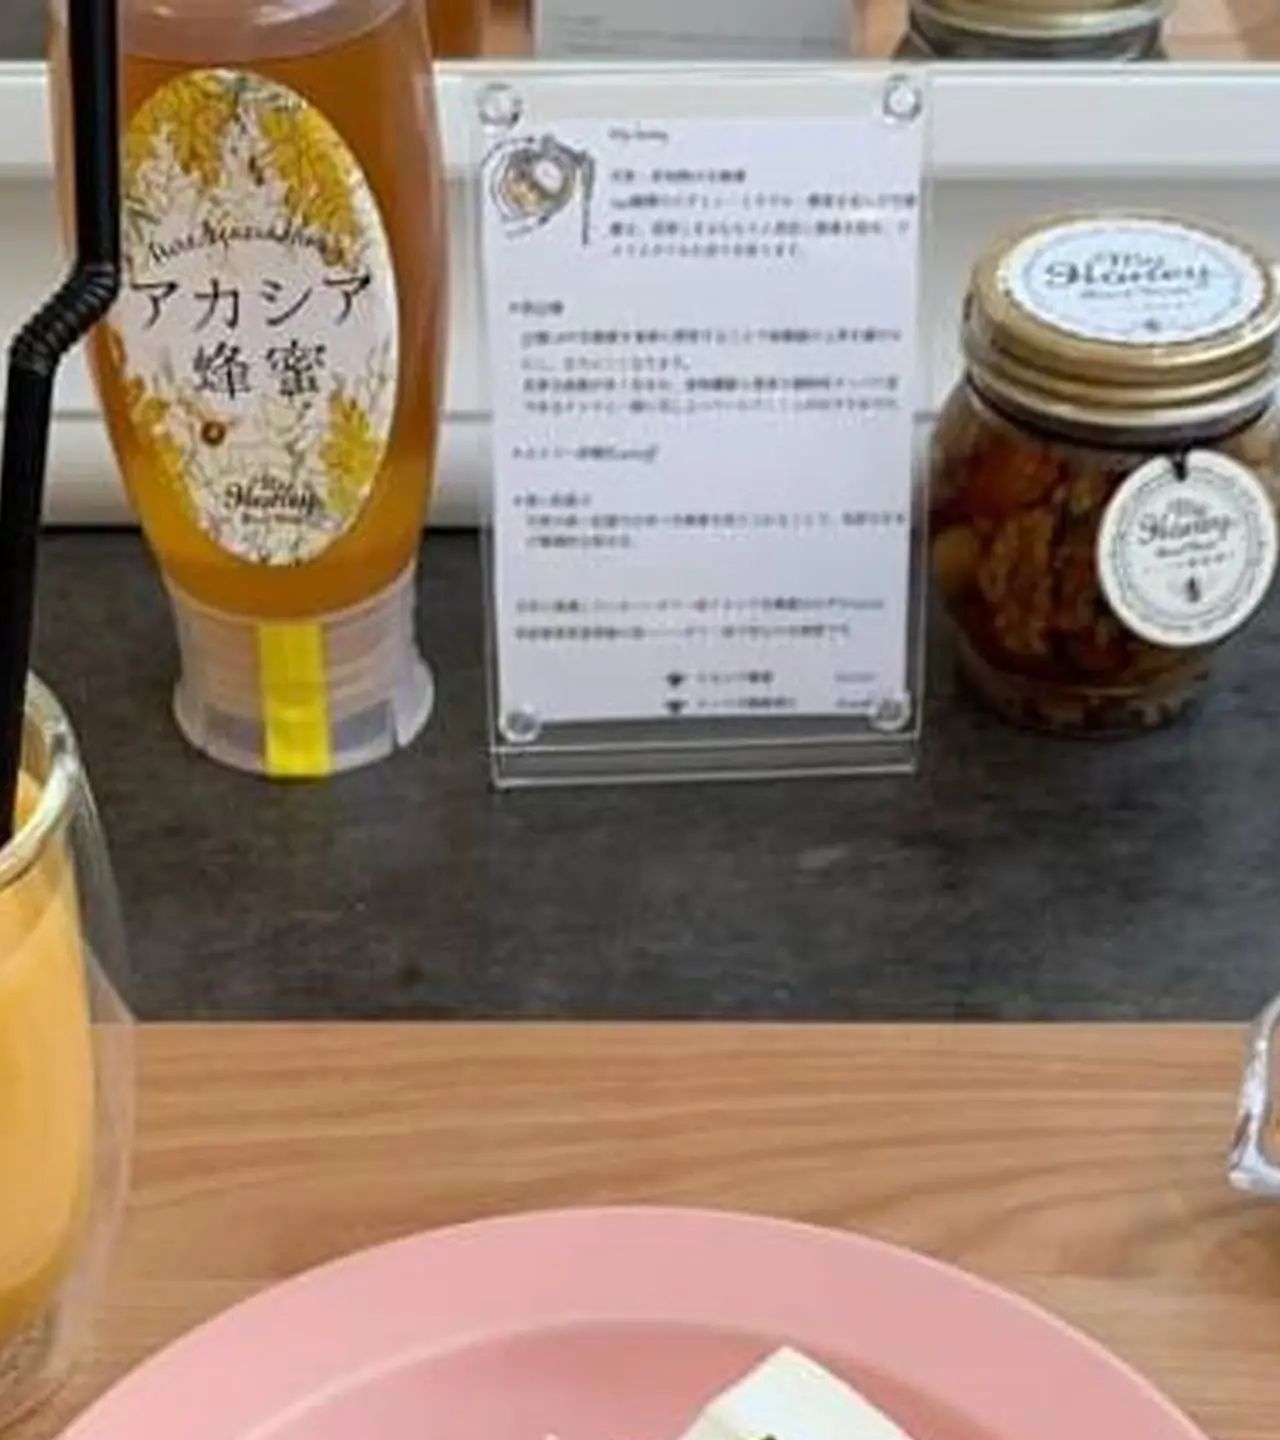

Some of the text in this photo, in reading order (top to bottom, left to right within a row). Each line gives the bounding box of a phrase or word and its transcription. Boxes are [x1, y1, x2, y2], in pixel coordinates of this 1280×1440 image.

[130, 270, 372, 332] アカシア
[192, 338, 326, 400] 蜂蜜
